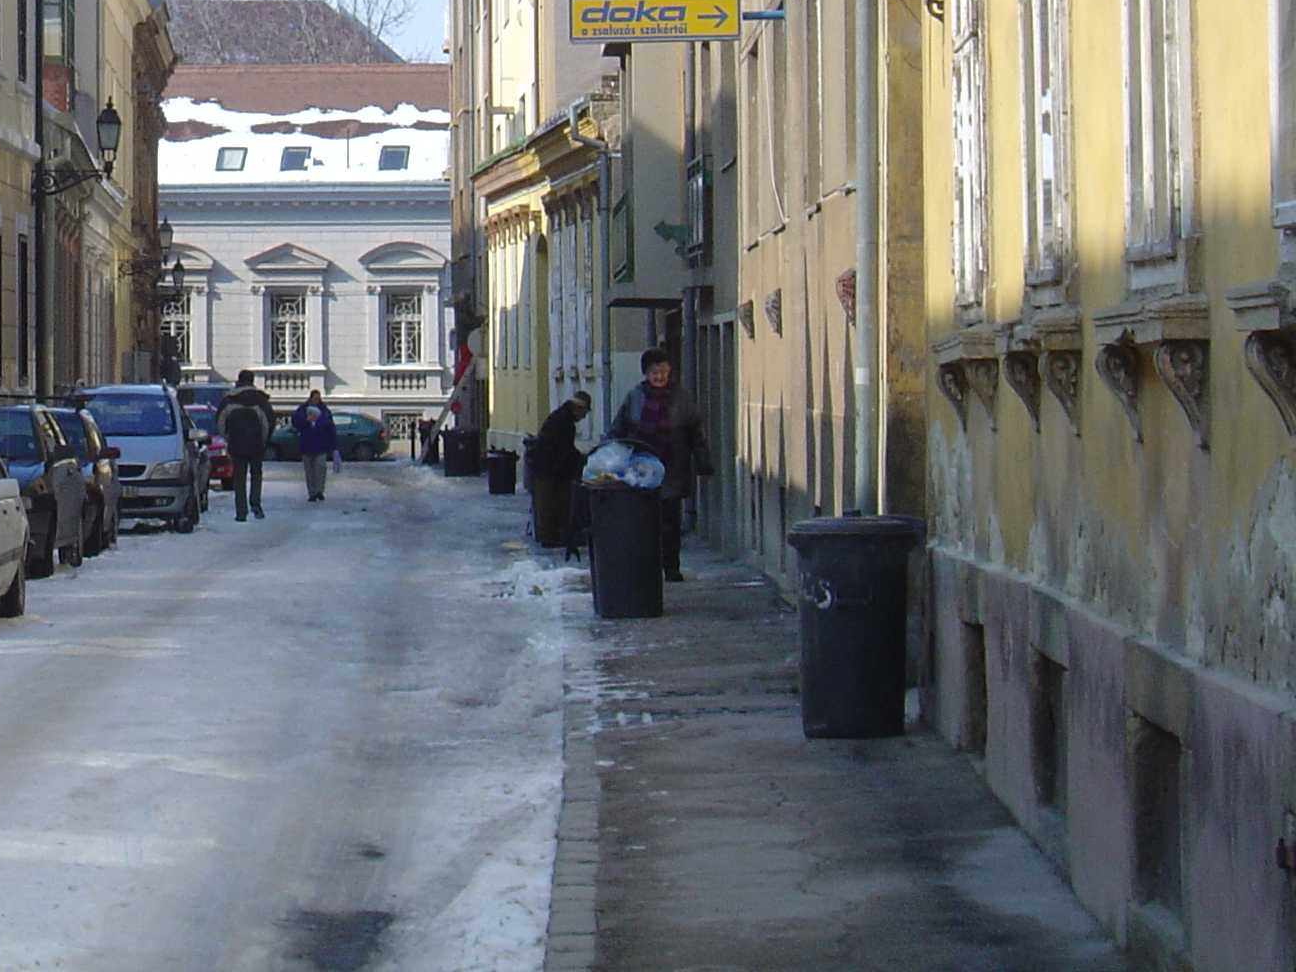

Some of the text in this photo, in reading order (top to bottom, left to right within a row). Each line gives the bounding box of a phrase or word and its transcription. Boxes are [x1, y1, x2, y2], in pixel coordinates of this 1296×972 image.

[581, 0, 687, 23] doka
[581, 28, 588, 36] a
[592, 24, 636, 36] zsaluzás
